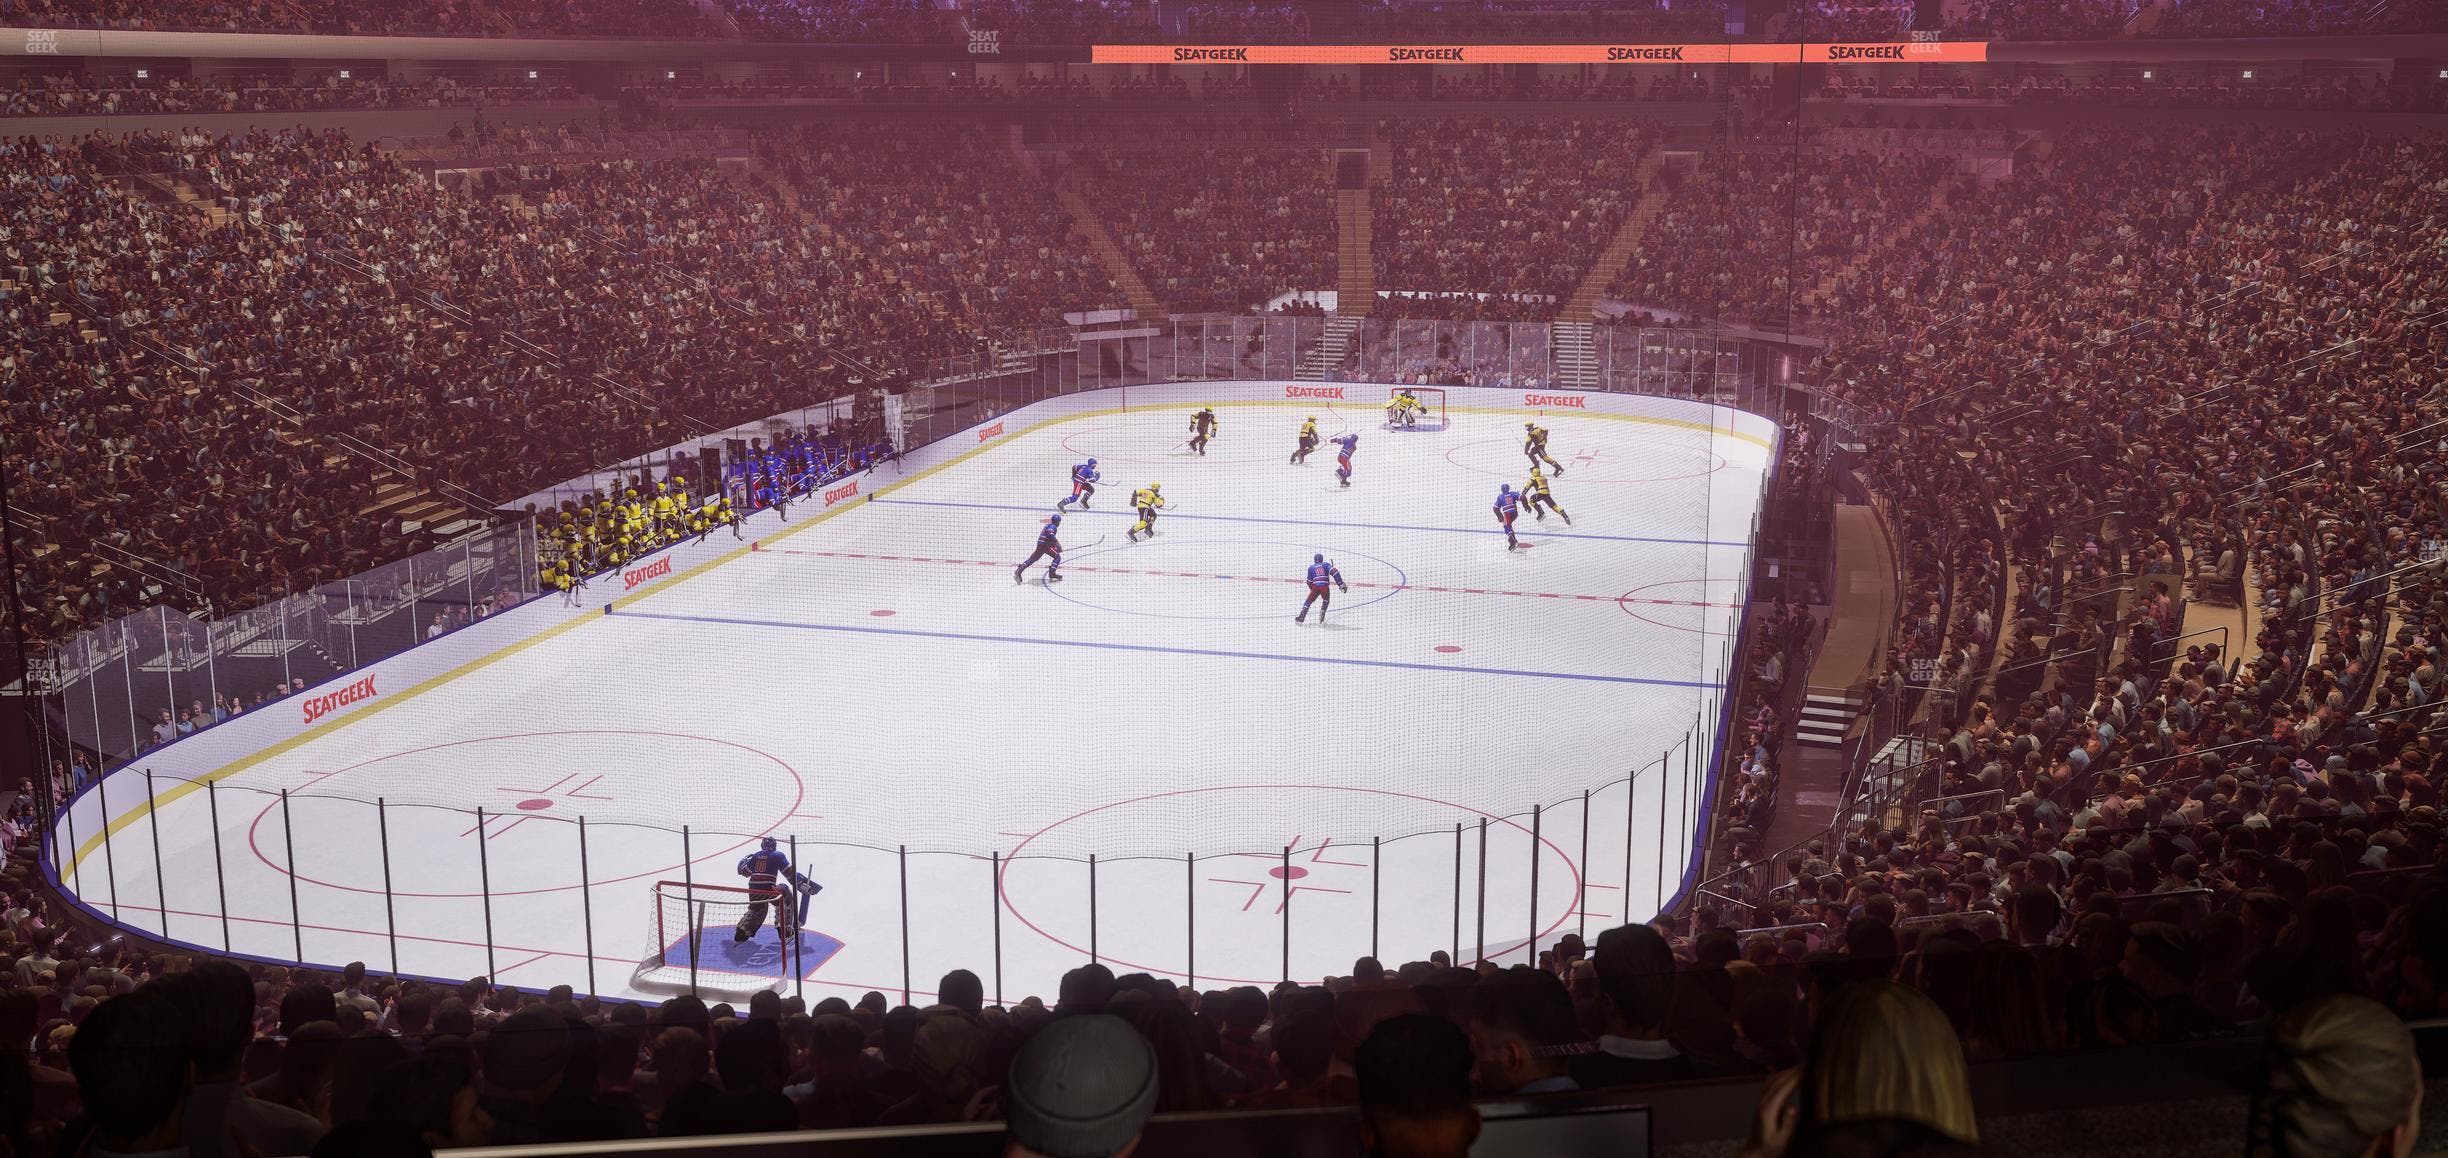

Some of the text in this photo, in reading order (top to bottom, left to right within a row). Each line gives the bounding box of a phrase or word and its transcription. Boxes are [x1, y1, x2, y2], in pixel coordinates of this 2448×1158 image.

[1174, 47, 1248, 61] SEATGEEK
[1389, 47, 1464, 61] SEATGEEK
[1607, 46, 1684, 61] SEATGEEK
[1828, 45, 1905, 60] SEATGEEK
[1285, 386, 1345, 400] SEATGEEK
[1524, 394, 1585, 408] SEATGEEK
[824, 480, 859, 508] SEATGEEK
[624, 554, 673, 591] SEATGEEK
[303, 672, 378, 724] SEATGEEK
